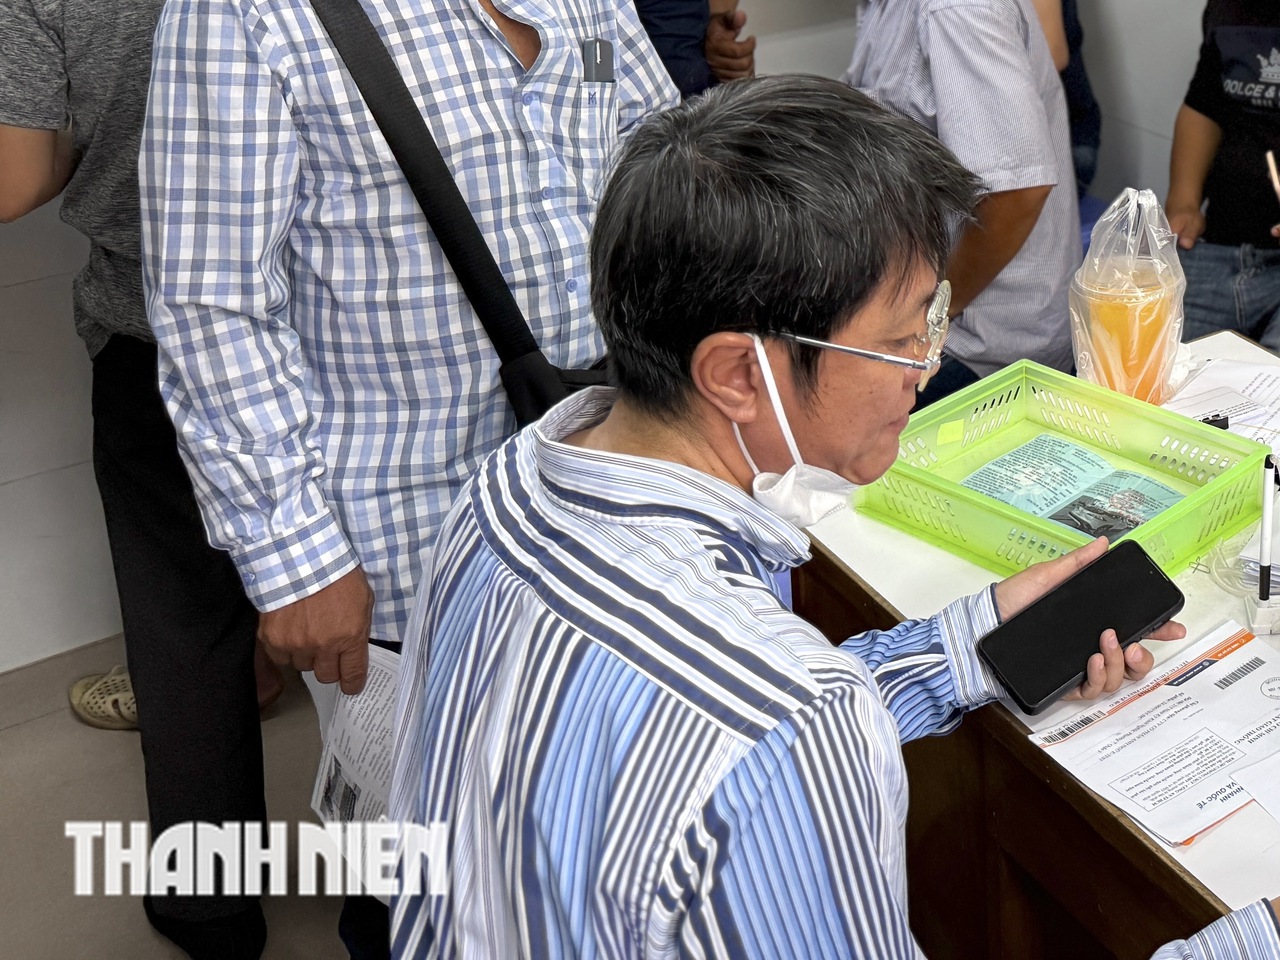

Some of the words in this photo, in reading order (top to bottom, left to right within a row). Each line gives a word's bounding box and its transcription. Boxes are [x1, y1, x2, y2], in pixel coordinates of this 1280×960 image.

[1264, 85, 1276, 98] &
[1225, 780, 1237, 791] VÀ
[1205, 786, 1227, 804] QUỐC
[1218, 785, 1244, 803] NHANH
[1195, 799, 1207, 810] TẾ
